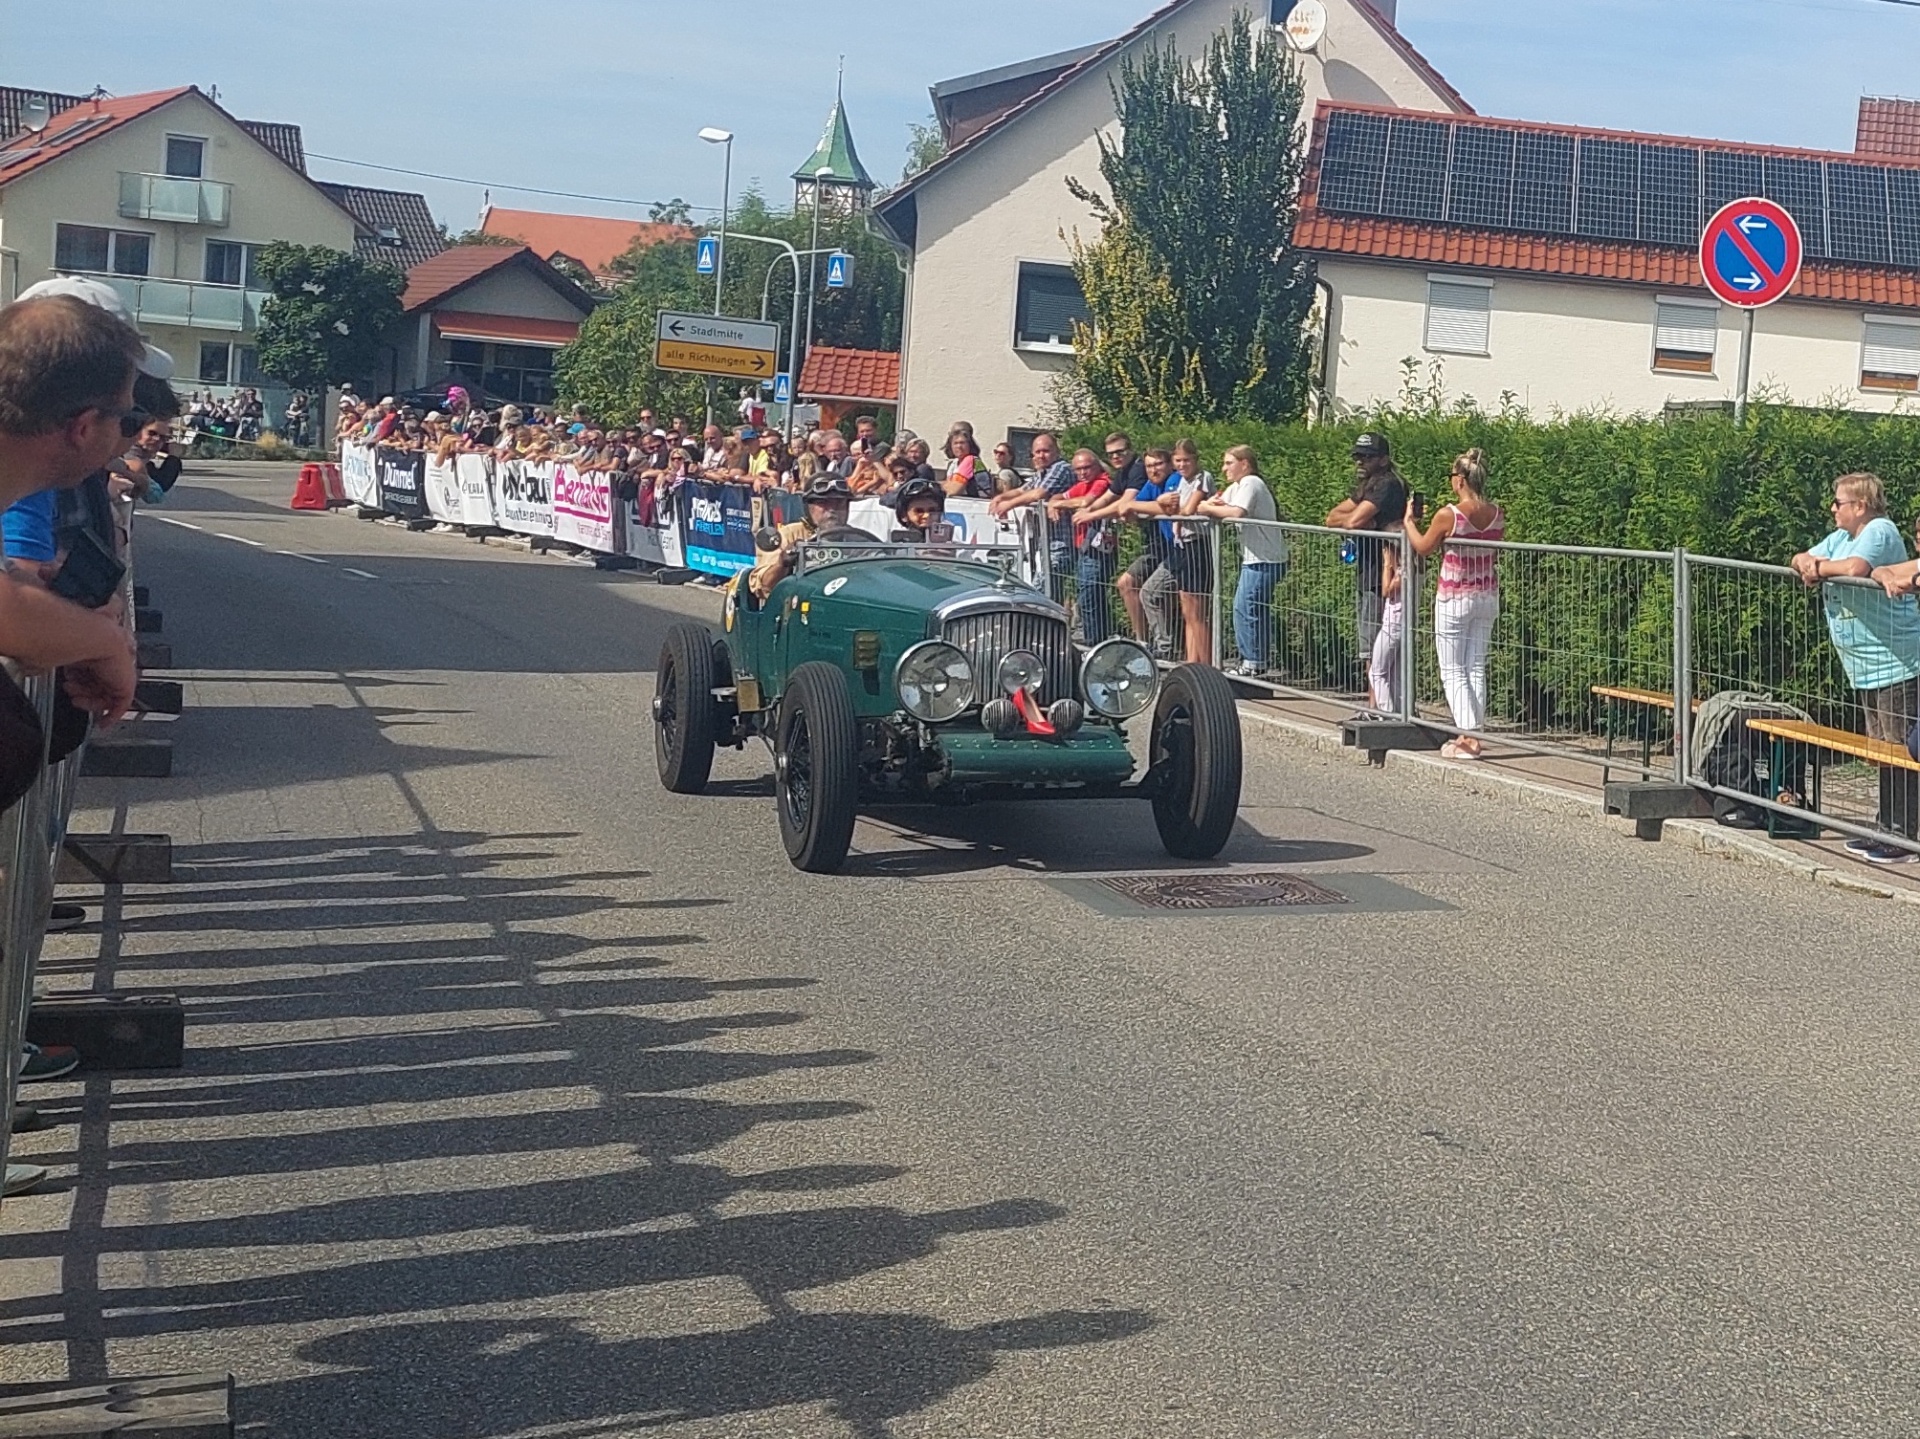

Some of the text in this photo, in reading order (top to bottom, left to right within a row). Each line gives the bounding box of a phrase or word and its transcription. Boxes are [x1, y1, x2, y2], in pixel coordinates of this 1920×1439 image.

[689, 325, 744, 340] Stadtmitte
[666, 349, 747, 367] alle Richtungen
